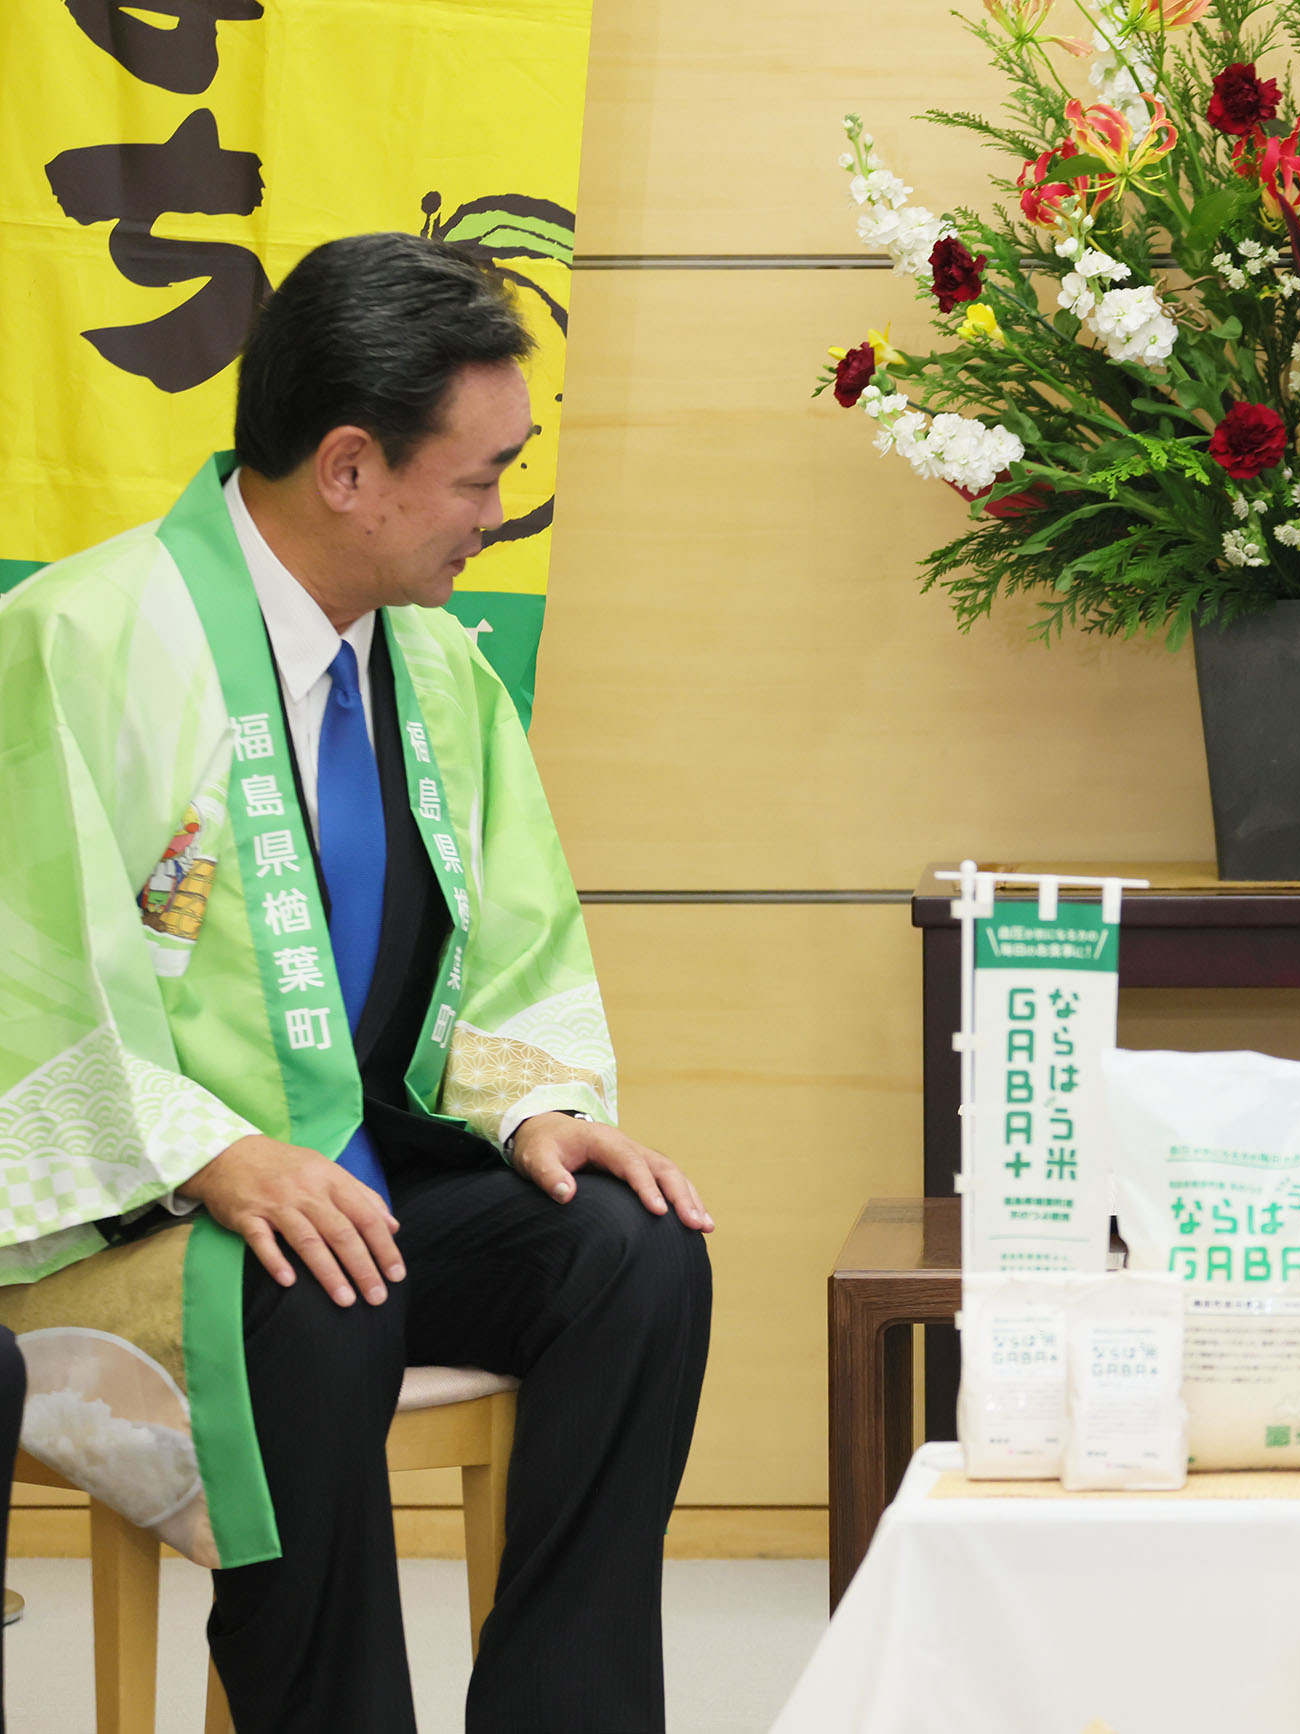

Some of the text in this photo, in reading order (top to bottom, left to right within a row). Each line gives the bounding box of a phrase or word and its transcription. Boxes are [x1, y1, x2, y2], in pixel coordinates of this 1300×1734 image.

[229, 713, 333, 1050] 福島県楢葉町
[1005, 988, 1035, 1178] GABA+
